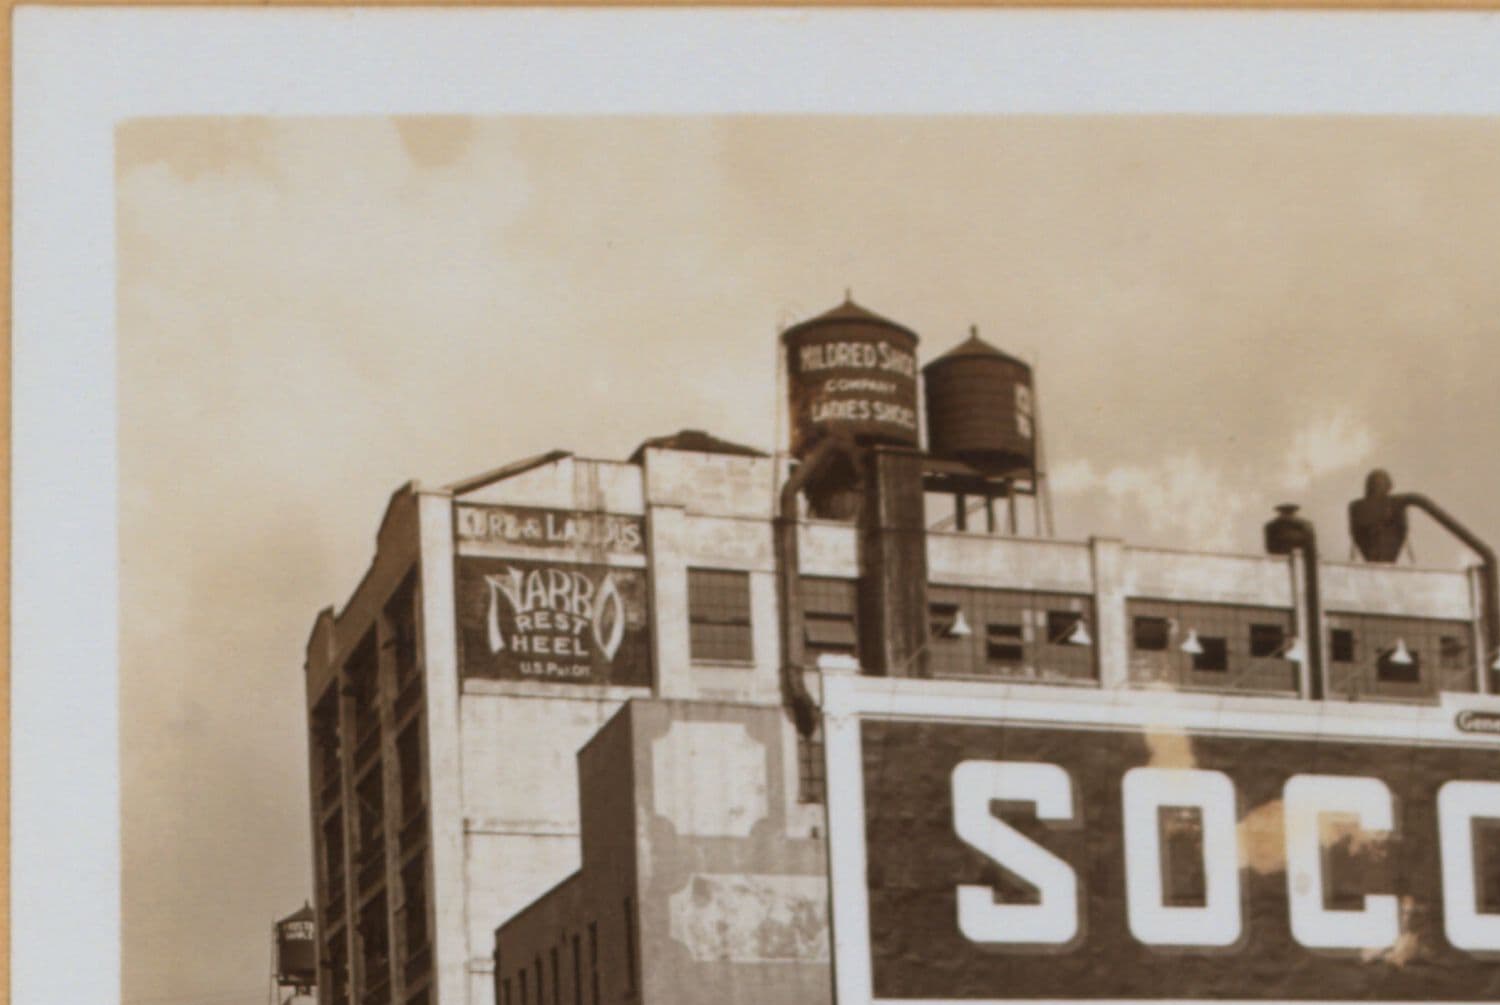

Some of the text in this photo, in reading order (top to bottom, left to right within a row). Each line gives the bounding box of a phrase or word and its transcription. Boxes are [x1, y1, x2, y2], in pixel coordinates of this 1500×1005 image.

[811, 399, 870, 423] LADIES
[516, 611, 590, 635] REST
[512, 635, 590, 656] HEEL
